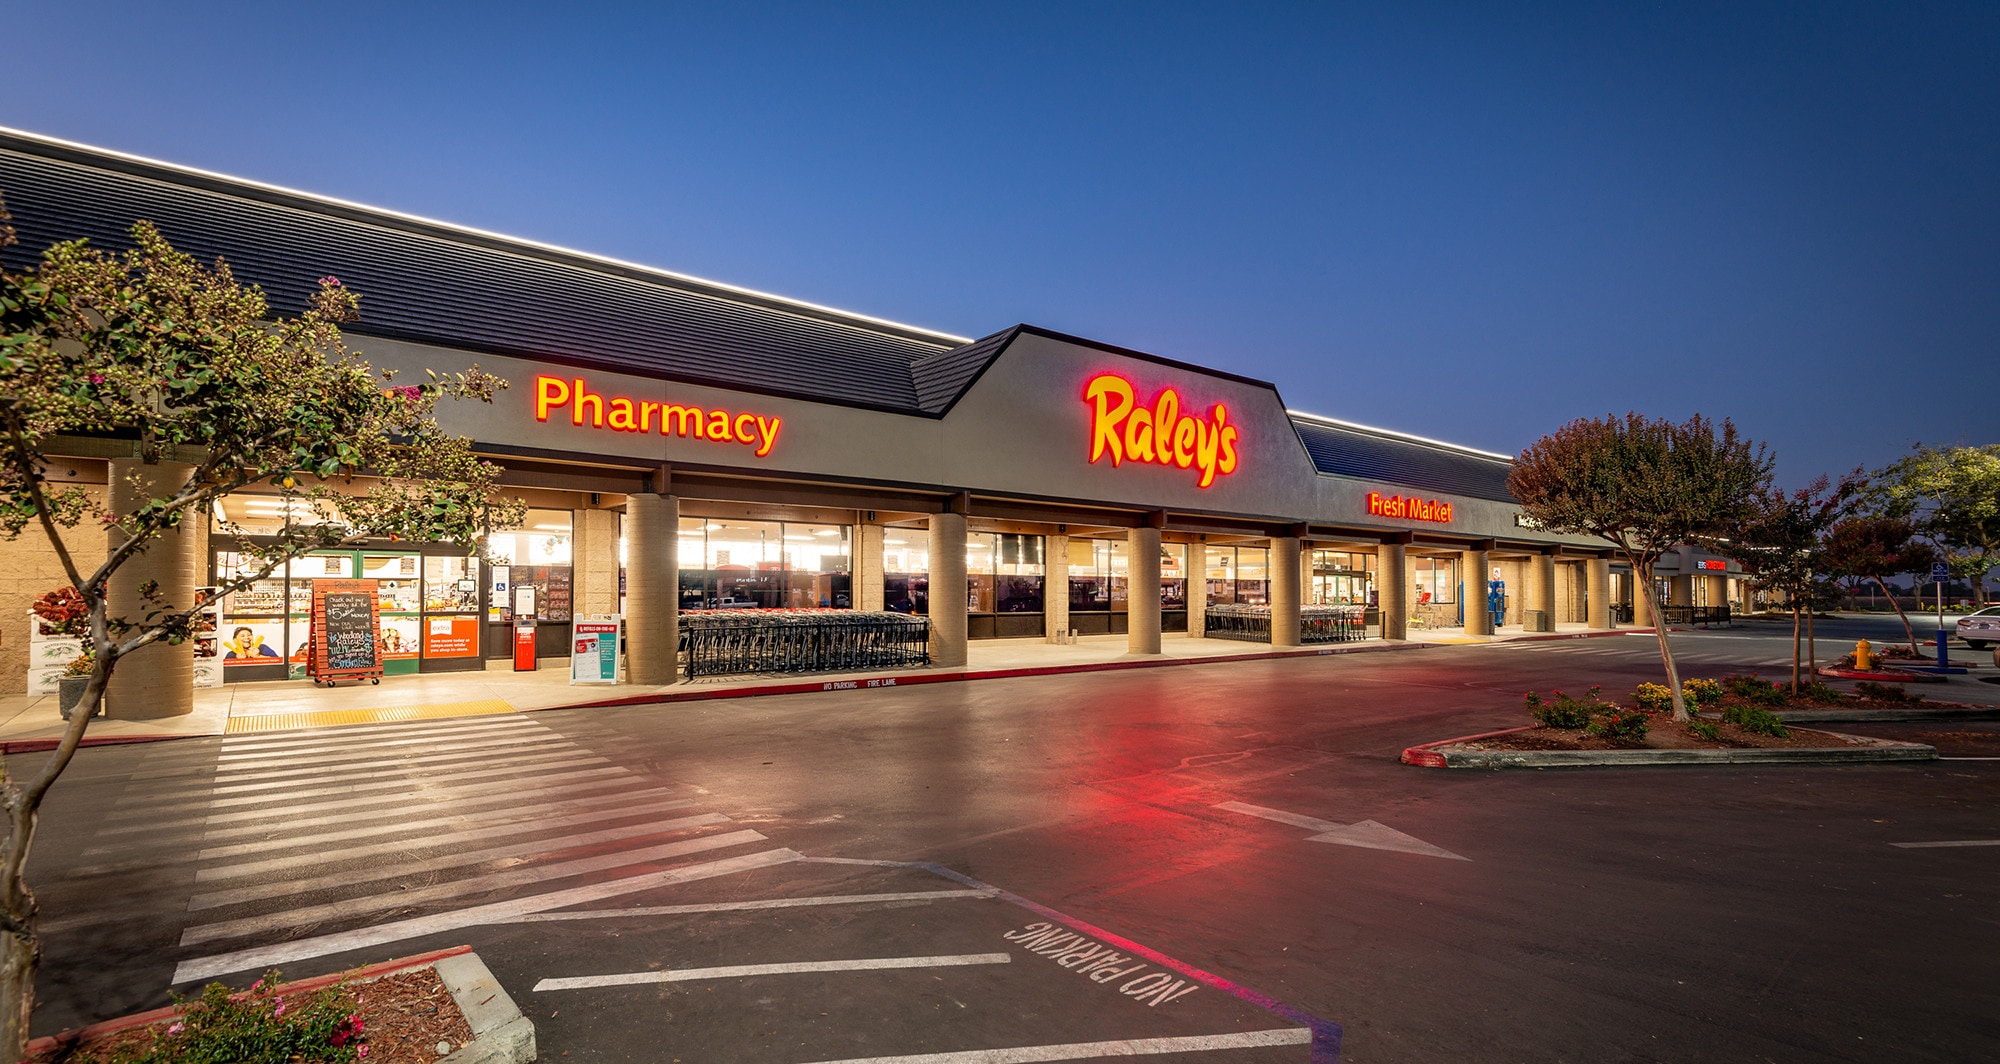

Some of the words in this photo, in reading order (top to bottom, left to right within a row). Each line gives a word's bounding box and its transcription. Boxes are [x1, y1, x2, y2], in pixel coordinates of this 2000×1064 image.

[536, 376, 781, 457] Pharmacy
[1083, 375, 1238, 488] Raley's
[1369, 492, 1406, 517] Fresh
[1408, 498, 1453, 522] Market
[823, 682, 832, 690] NO
[833, 681, 857, 690] PARKING
[882, 678, 897, 686] LANE
[1003, 922, 1148, 984] PARKING
[1119, 972, 1200, 1007] NO
